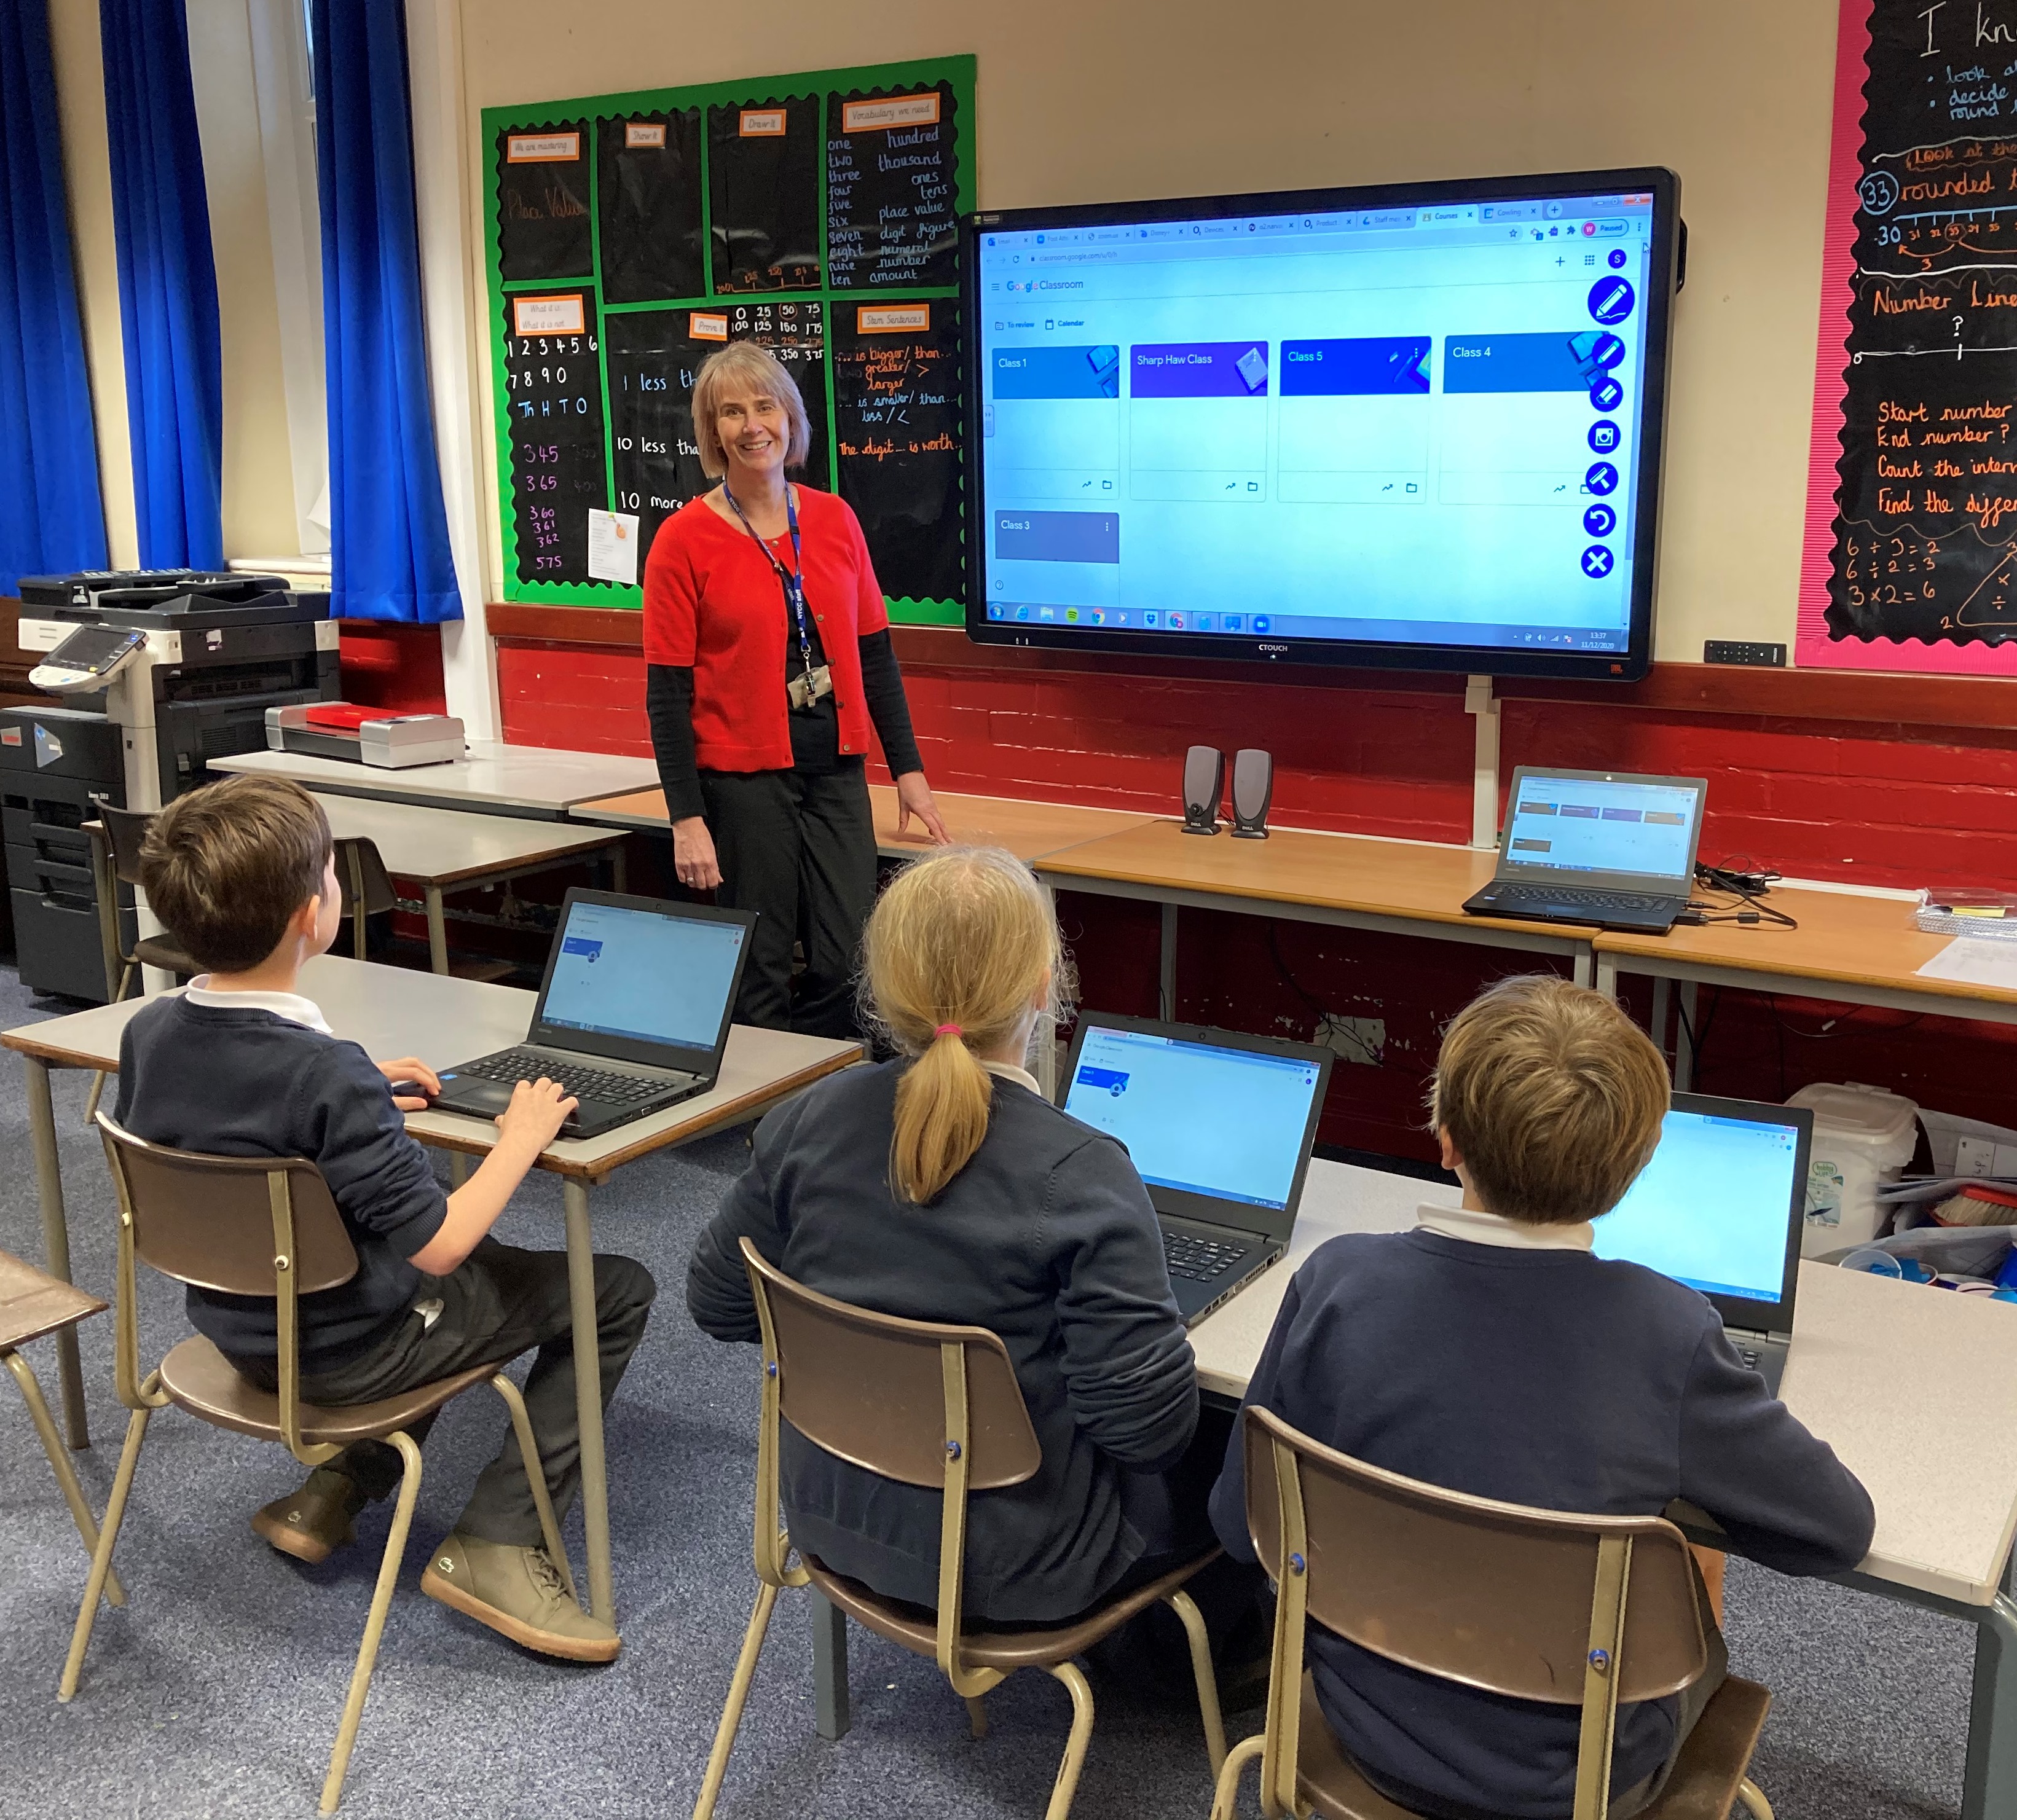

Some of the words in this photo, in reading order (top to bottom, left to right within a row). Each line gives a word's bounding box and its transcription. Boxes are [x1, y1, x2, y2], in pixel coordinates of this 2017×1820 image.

[1918, 1, 1946, 57] I
[1946, 65, 1991, 84] look
[1949, 83, 2009, 106] decide
[852, 109, 895, 121] Vocabulary
[912, 103, 930, 113] need
[1950, 101, 2000, 120] round
[749, 119, 769, 128] Draw
[633, 130, 651, 140] Show
[828, 139, 852, 151] one
[887, 125, 940, 149] hundred
[538, 141, 567, 153] mastering
[1964, 143, 1983, 157] at
[829, 153, 852, 168] two
[878, 151, 942, 173] thousand
[828, 170, 862, 184] three
[911, 172, 939, 184] ones
[828, 186, 852, 200] four
[921, 184, 948, 199] tens
[1865, 181, 1890, 206] 33
[1901, 170, 1995, 201] rounded
[506, 189, 543, 220] Place
[546, 187, 588, 218] Value
[828, 200, 852, 215] five
[879, 205, 910, 225] place
[914, 200, 945, 215] value
[1497, 208, 1522, 218] Cowling
[828, 216, 849, 228] six
[828, 231, 863, 244] seven
[880, 225, 906, 243] digit
[917, 221, 956, 240] figure
[1877, 226, 1901, 246] 30
[828, 243, 865, 262] eight
[878, 240, 929, 256] numeral
[1614, 254, 1621, 264] S
[828, 261, 856, 272] nine
[876, 256, 930, 269] number
[831, 272, 852, 285] ten
[870, 269, 918, 283] amount
[1007, 280, 1039, 292] Google
[1040, 281, 1083, 291] Classroom
[1874, 286, 1952, 316] Number
[1971, 280, 2017, 308] Line
[736, 307, 747, 320] 0
[757, 307, 771, 318] 25
[782, 305, 795, 315] 50
[805, 304, 820, 314] 75
[867, 315, 884, 325] Stem
[887, 315, 922, 324] Sentences
[699, 320, 717, 332] Prove
[731, 321, 749, 332] 100
[755, 321, 772, 332] 125
[780, 321, 798, 332] 150
[806, 323, 822, 335] 175
[1952, 316, 1964, 337] ?
[508, 341, 513, 358] 1
[522, 340, 531, 355] 2
[539, 339, 548, 356] 3
[557, 339, 565, 353] 4
[571, 337, 580, 353] 5
[588, 335, 598, 351] 6
[780, 348, 798, 360] 350
[805, 349, 824, 361] 375
[1453, 347, 1482, 358] Class
[1484, 347, 1491, 358] 4
[998, 358, 1021, 367] Class
[1023, 358, 1027, 367] 1
[1137, 355, 1163, 366] Sharp
[1165, 355, 1186, 364] Haw
[1187, 354, 1212, 364] Class
[1288, 351, 1316, 361] Class
[1316, 351, 1323, 361] 5
[510, 375, 517, 389] 7
[524, 371, 532, 387] 8
[541, 367, 549, 383] 9
[557, 367, 567, 383] 0
[624, 375, 627, 391] 1
[640, 373, 666, 391] less
[868, 379, 905, 396] larger
[518, 401, 535, 418] Th
[542, 400, 550, 417] H
[559, 399, 568, 414] T
[862, 410, 883, 422] less
[1878, 401, 1929, 423] Start
[1940, 399, 2013, 422] number
[618, 437, 632, 451] 10
[642, 436, 666, 453] less
[677, 439, 700, 455] tha
[1877, 426, 1911, 448] End
[1921, 426, 1994, 446] number
[524, 444, 558, 463] 345
[839, 442, 859, 456] The
[862, 437, 894, 463] digit
[908, 441, 918, 453] is
[1878, 454, 1924, 479] Count
[1934, 460, 1964, 477] the
[526, 475, 557, 492] 365
[621, 492, 640, 509] 10
[651, 495, 683, 509] more
[1879, 487, 1914, 514] Find
[1924, 489, 1954, 513] the
[530, 506, 554, 520] 360
[533, 520, 554, 534] 361
[1001, 520, 1023, 530] Class
[1024, 521, 1030, 530] 3
[536, 533, 560, 548] 362
[1847, 537, 1859, 556] 6
[1891, 538, 1905, 557] 3
[1927, 541, 1941, 554] 2
[536, 555, 562, 570] 575
[1846, 559, 1858, 579] 6
[1888, 560, 1900, 573] 2
[1923, 557, 1935, 570] 3
[1849, 586, 1865, 606] 3
[1885, 584, 1901, 603] 2
[1923, 581, 1935, 598] 6
[1941, 616, 1954, 630] 2
